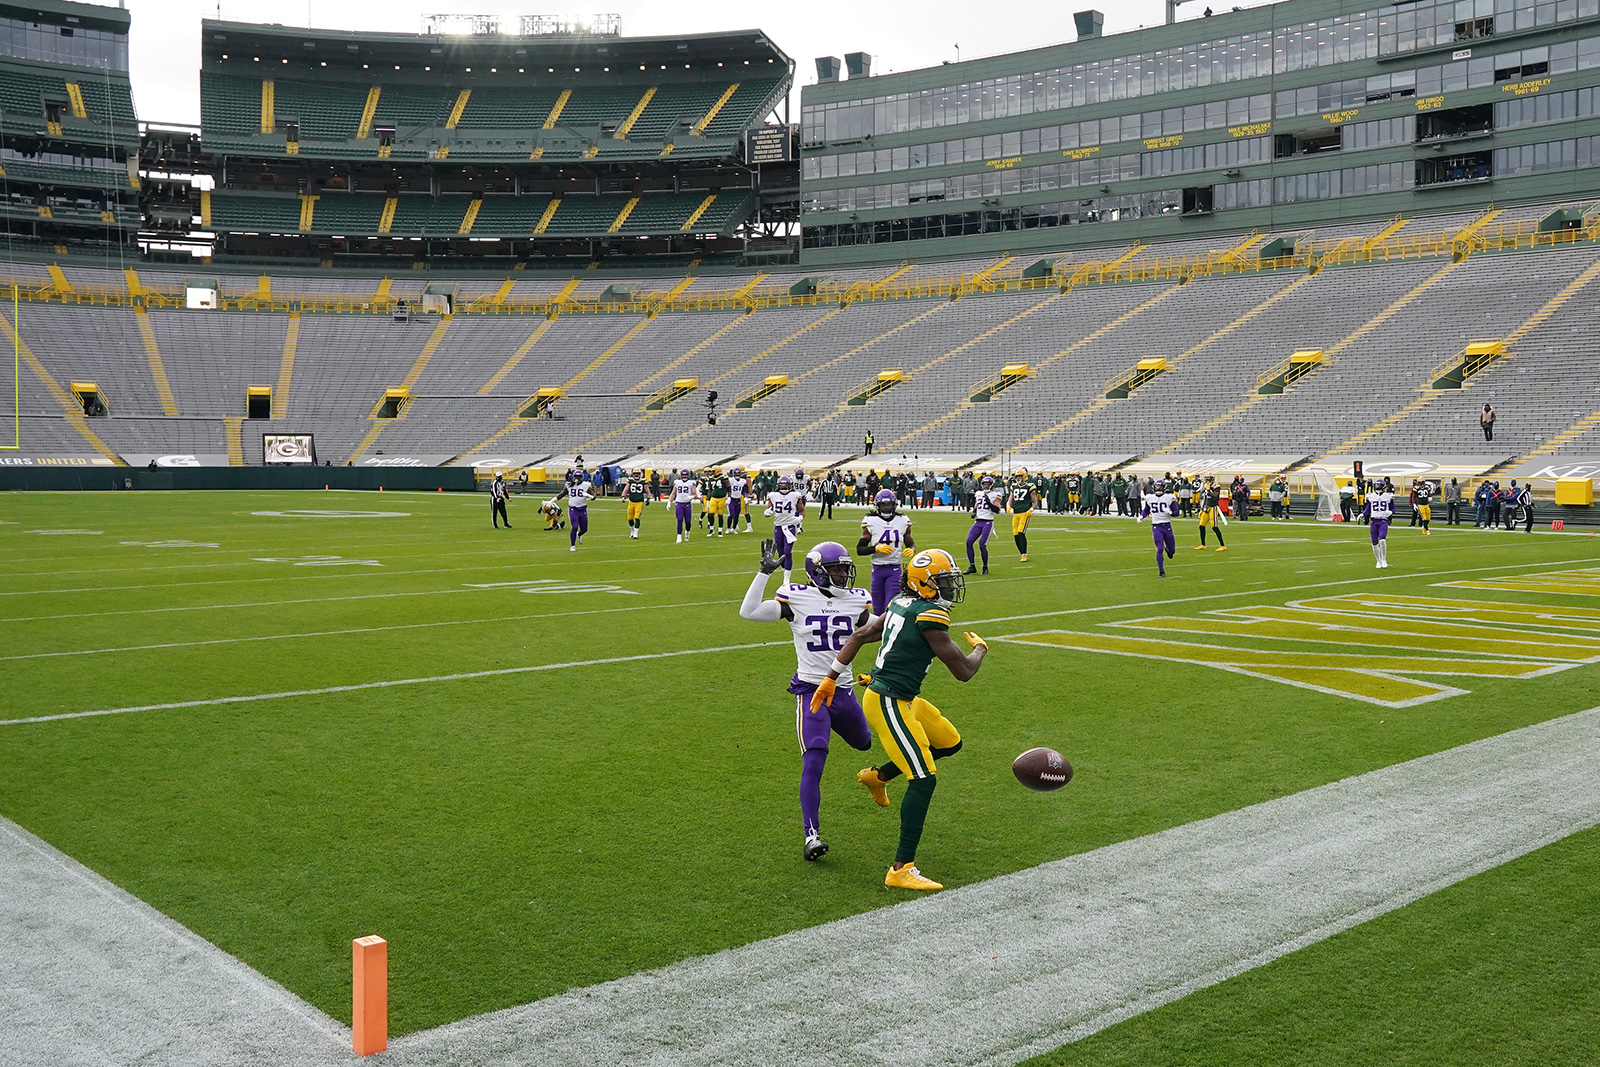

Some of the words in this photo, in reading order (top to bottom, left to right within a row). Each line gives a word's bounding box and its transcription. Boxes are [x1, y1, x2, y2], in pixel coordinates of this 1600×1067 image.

[1519, 78, 1552, 89] ADDERLEY
[1414, 98, 1425, 106] JIM
[1426, 95, 1445, 104] RINGO
[1322, 112, 1340, 120] WILLIE
[1341, 109, 1359, 117] WOOD
[1242, 122, 1271, 132] MICHALSKE
[1143, 137, 1165, 145] FORREST
[1075, 146, 1100, 155] ROBINSON
[1001, 156, 1023, 164] KRAMER
[630, 484, 643, 494] 63
[710, 480, 723, 490] 74
[570, 489, 584, 498] 96
[1013, 489, 1028, 501] 87
[1417, 489, 1428, 498] 30
[774, 501, 793, 514] 54
[1372, 501, 1388, 512] 29
[1553, 521, 1562, 530] 10
[878, 529, 900, 549] 41
[805, 615, 854, 652] 32
